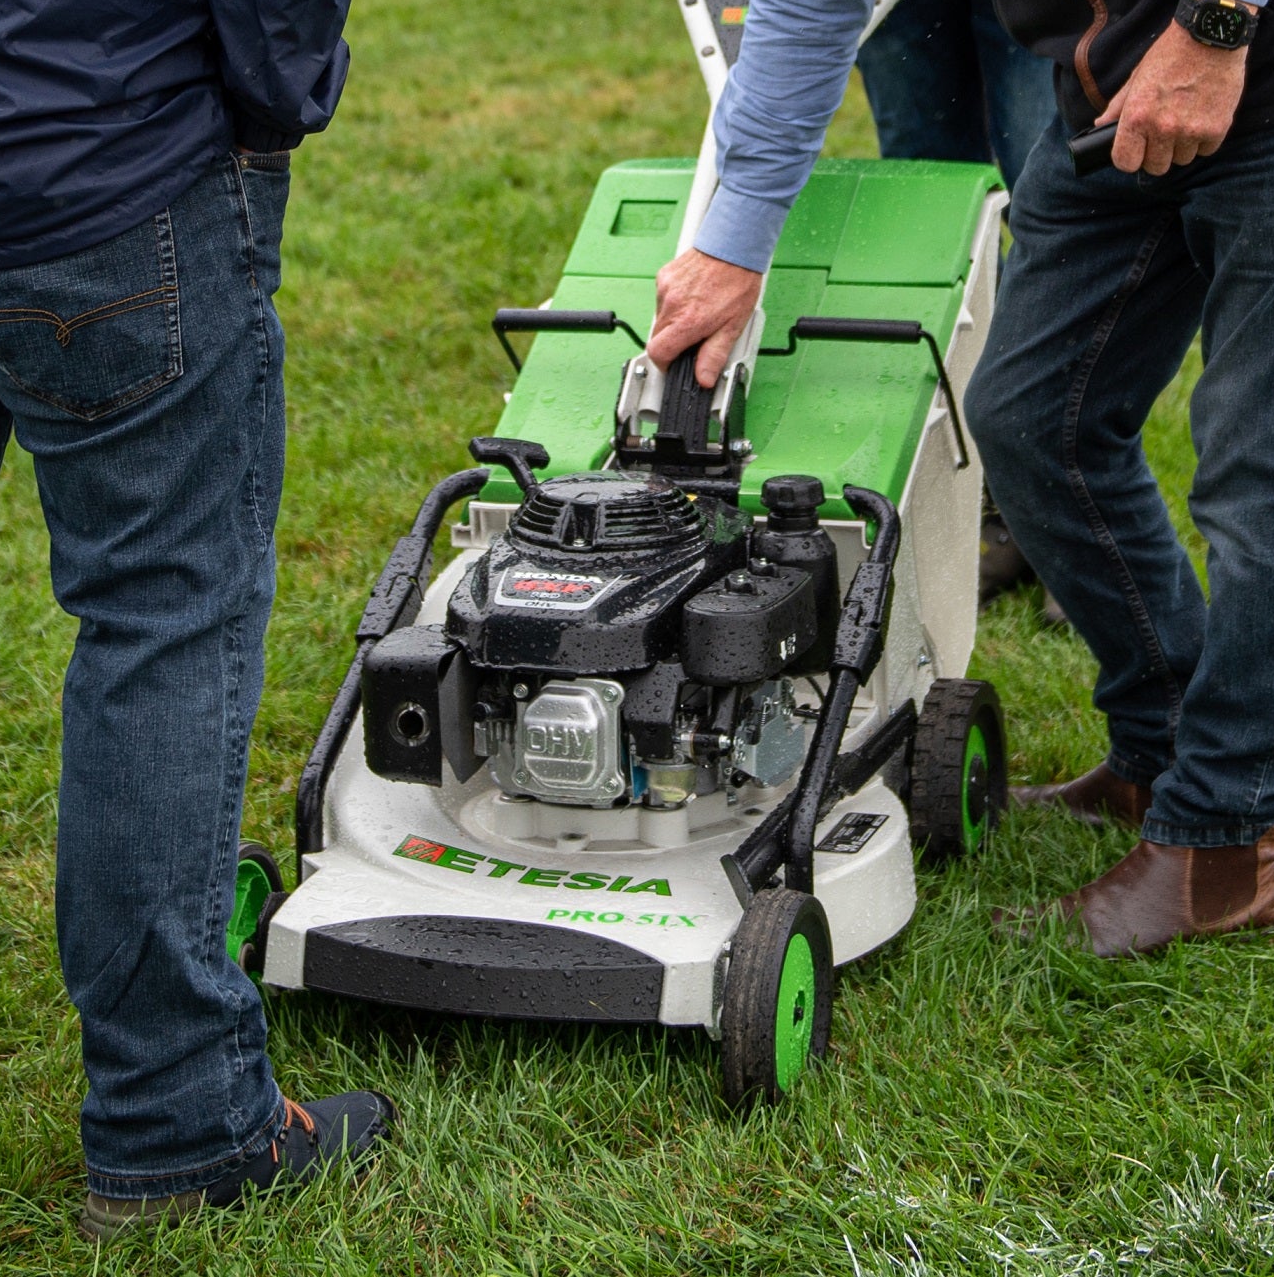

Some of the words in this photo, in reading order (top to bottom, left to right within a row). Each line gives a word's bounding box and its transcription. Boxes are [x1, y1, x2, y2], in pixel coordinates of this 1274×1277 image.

[512, 571, 604, 584] HONDA
[526, 725, 592, 759] OHV
[437, 846, 672, 897] ETESIA
[545, 908, 625, 924] PRO
